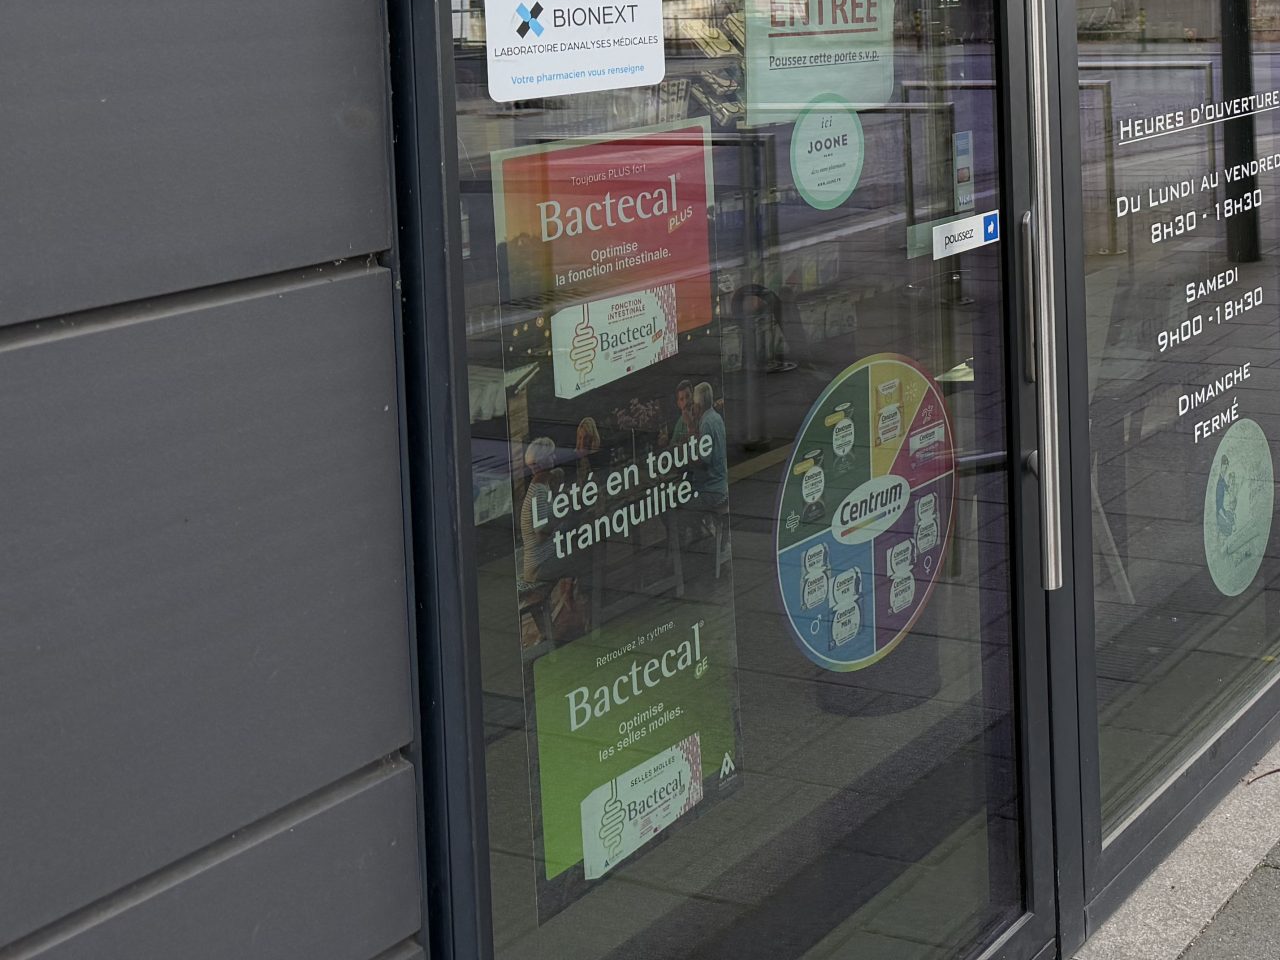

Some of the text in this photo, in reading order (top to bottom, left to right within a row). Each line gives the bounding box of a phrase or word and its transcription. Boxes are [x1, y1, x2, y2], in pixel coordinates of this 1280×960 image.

[554, 4, 638, 28] BIONEXT
[494, 35, 659, 58] LABORATOIRE D'ANALYSES MÉDICALES
[769, 48, 879, 68] Poussez cette porte s.v.p.
[511, 64, 645, 85] Votre pharmacien vous renseigne
[822, 116, 833, 128] ici
[1120, 91, 1280, 140] HEURES D'OUVERTURE
[808, 134, 848, 154] JOONE
[571, 163, 646, 188] Toujours PLUS fort
[1116, 195, 1141, 218] DU
[1149, 179, 1194, 207] LUNDI
[1201, 172, 1218, 192] AU
[669, 206, 693, 230] PLUS
[944, 229, 974, 250] poussez
[591, 241, 638, 264] Optimise
[556, 247, 672, 286] la fonction intestinale.
[1186, 267, 1238, 304] SAMEDI
[608, 304, 646, 320] INTESTINALE
[611, 298, 642, 312] FONCTION
[1178, 362, 1251, 416] DIMANCHE
[1194, 396, 1240, 444] FERMÉ
[531, 433, 713, 530] L'été en toute
[840, 482, 902, 526] Centrum
[596, 642, 637, 668] Retrouvez
[638, 635, 645, 646] le
[695, 657, 709, 677] GE
[618, 702, 664, 734] Optimise
[600, 708, 684, 762] les selles molles.
[630, 771, 653, 788] SELLES
